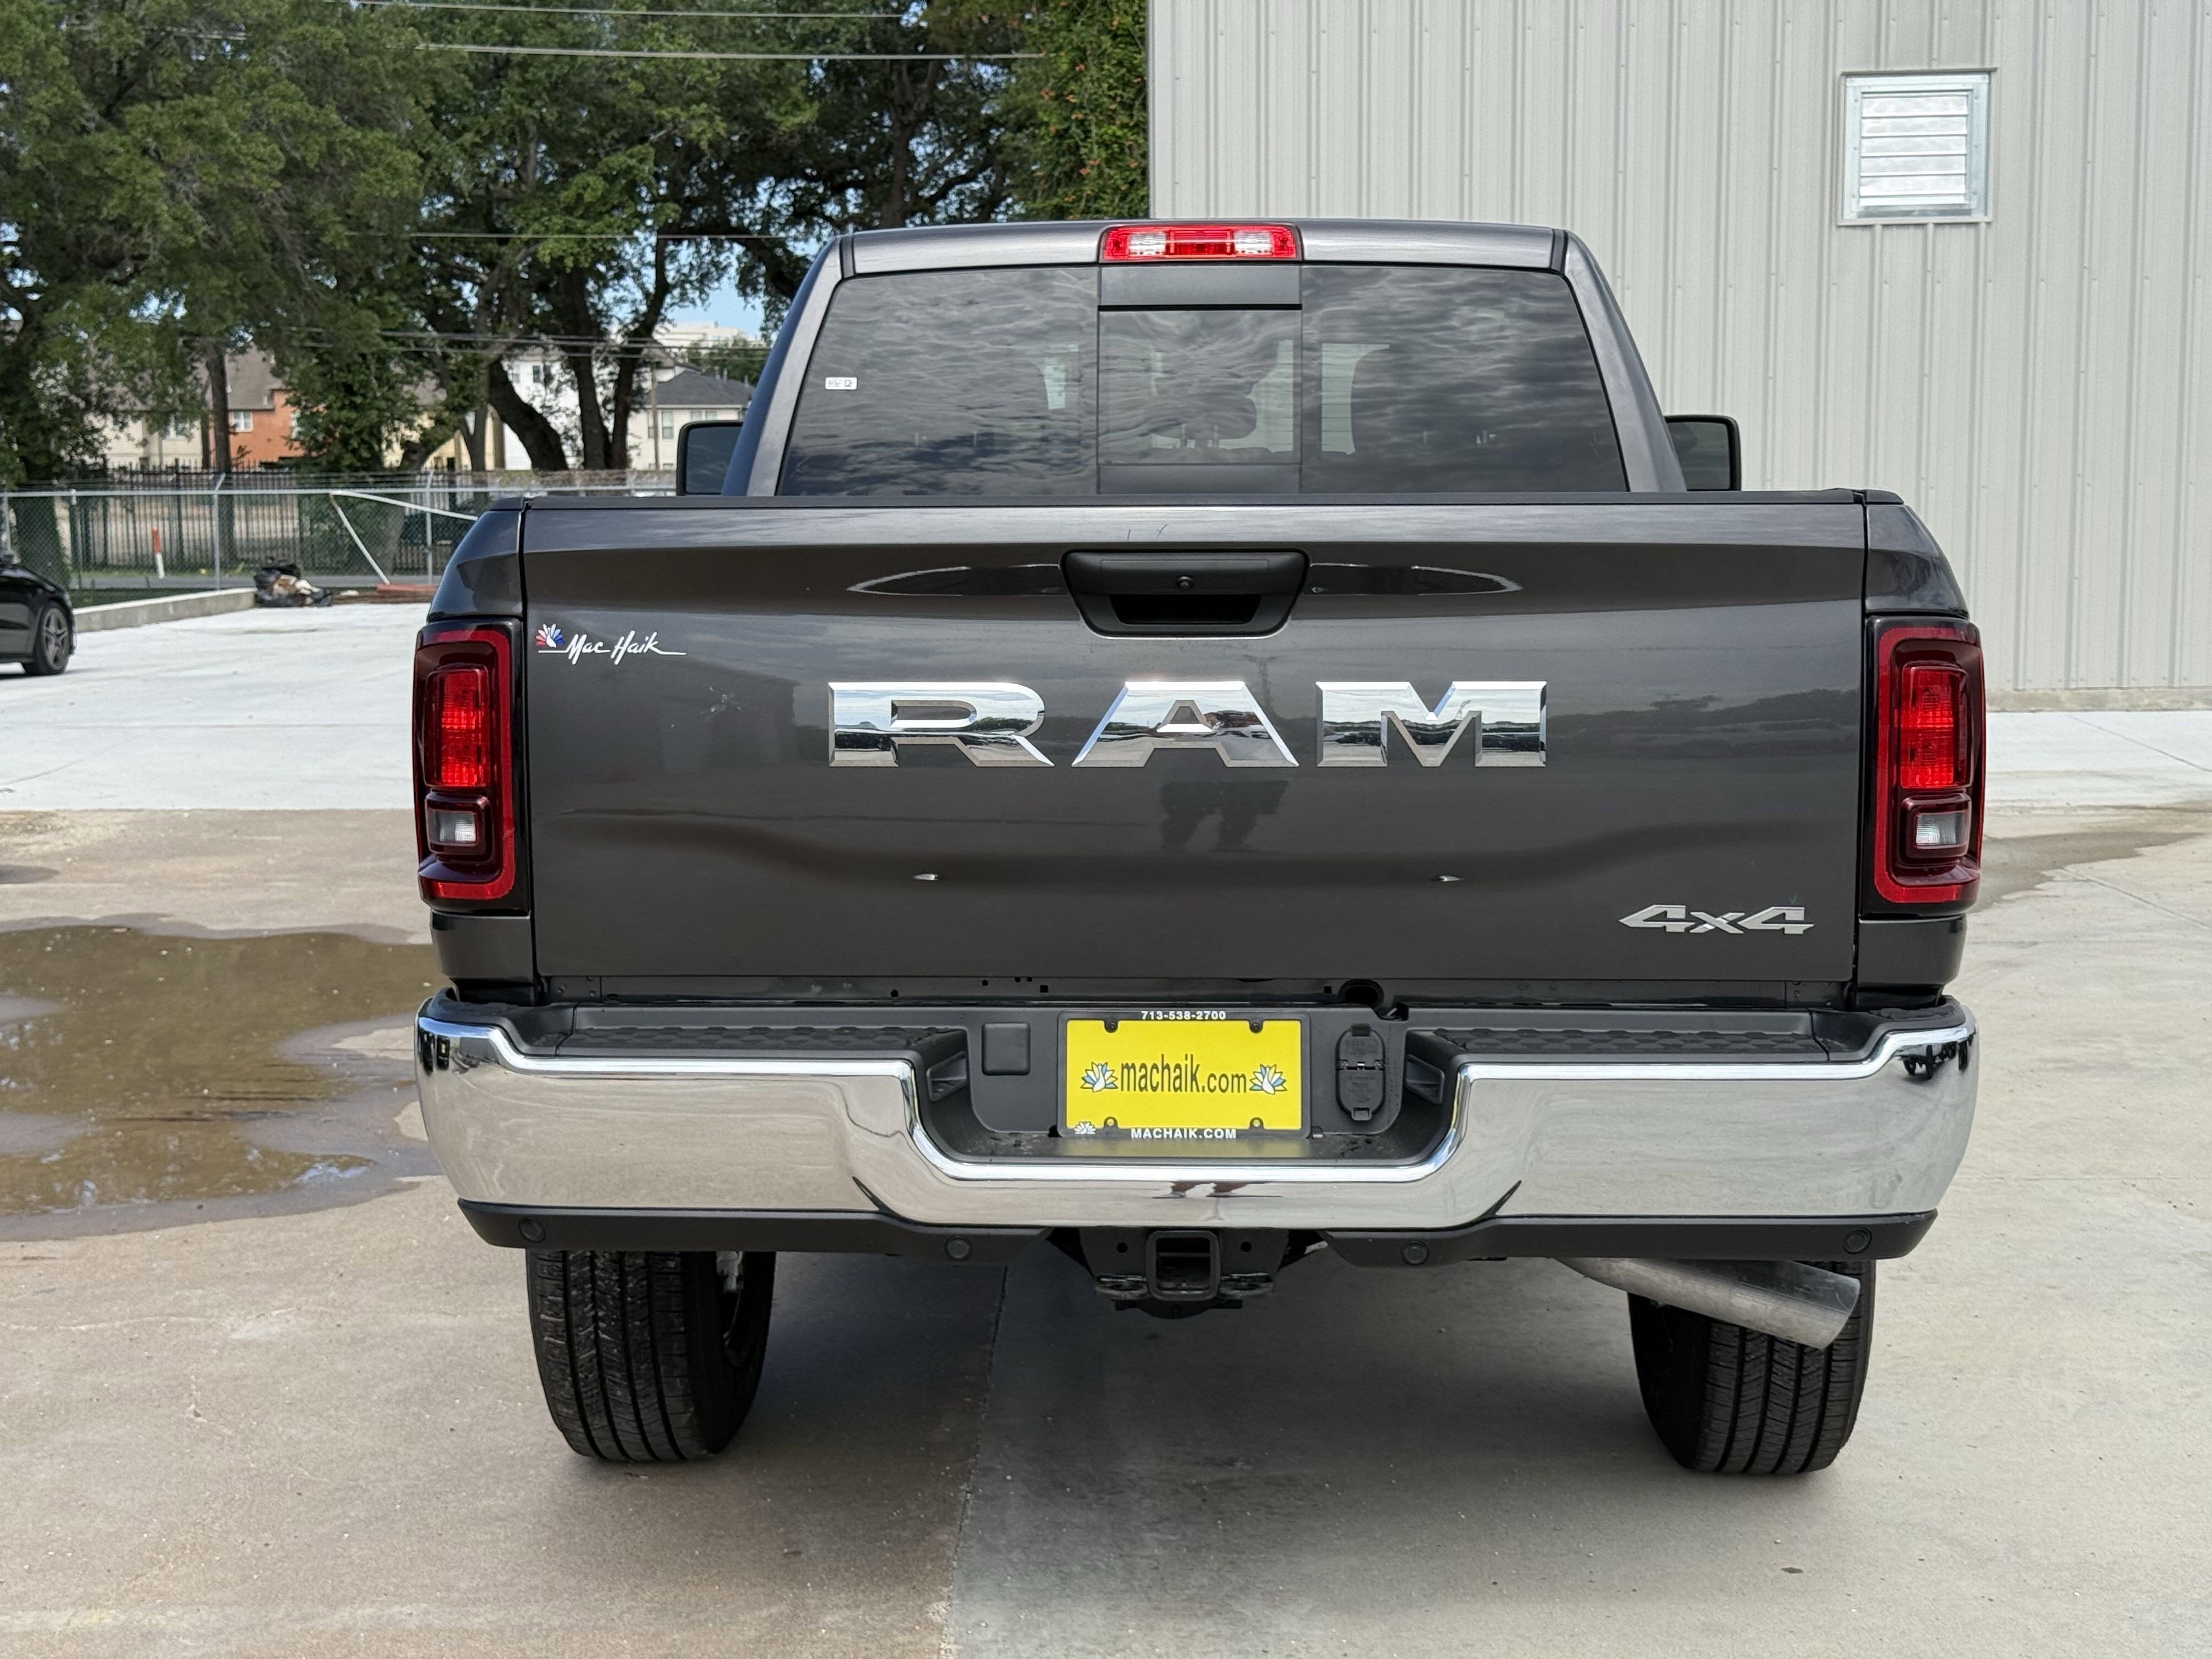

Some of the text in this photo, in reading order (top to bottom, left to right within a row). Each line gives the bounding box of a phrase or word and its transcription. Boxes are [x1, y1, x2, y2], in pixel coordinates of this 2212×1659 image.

[538, 630, 687, 665] Mac Haik
[828, 681, 1548, 768] RAM
[1618, 904, 1816, 934] 4x4
[1141, 1010, 1226, 1020] 713-538-2700
[1120, 1053, 1247, 1093] machaik.com
[1131, 1128, 1237, 1139] MACHAIK.COM
